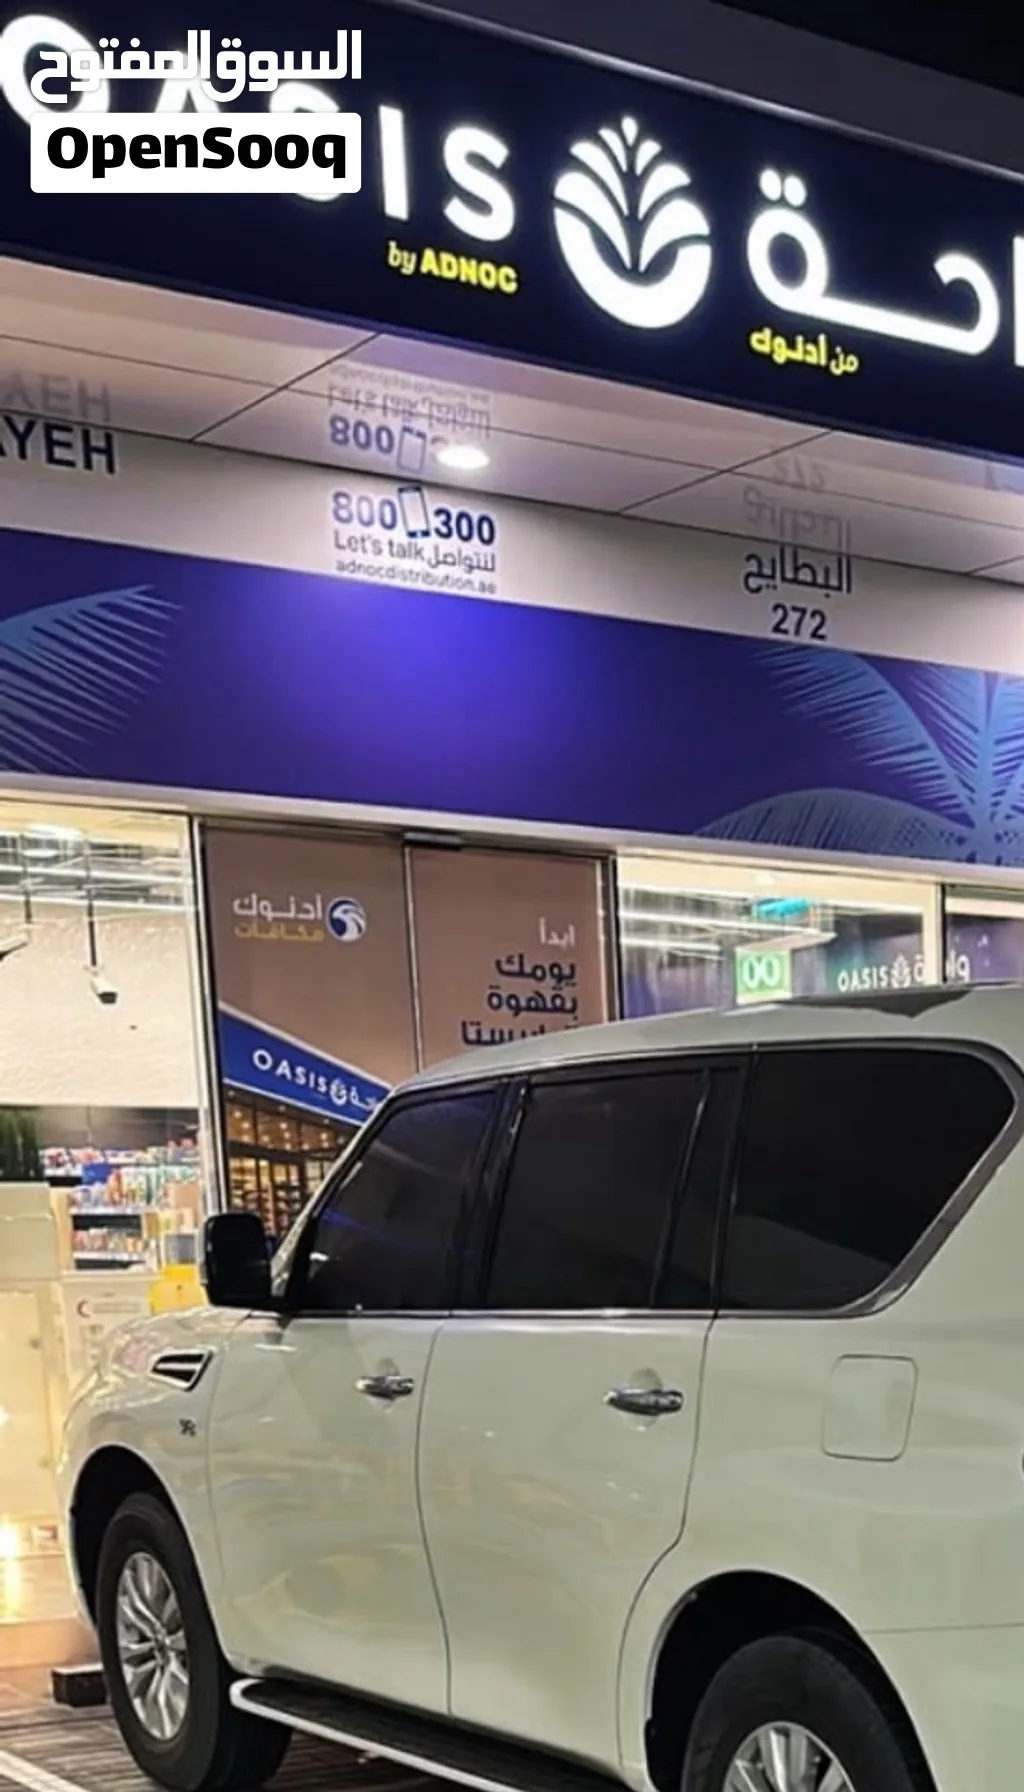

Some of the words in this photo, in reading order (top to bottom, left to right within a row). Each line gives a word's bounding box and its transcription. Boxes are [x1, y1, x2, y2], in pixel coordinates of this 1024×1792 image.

[388, 240, 417, 275] by
[420, 247, 518, 294] ADNOC
[829, 345, 859, 375] من
[0, 414, 116, 475] YEH
[332, 491, 398, 530] 800
[433, 507, 496, 546] 300
[334, 530, 383, 556] Let's
[388, 540, 425, 563] talk
[335, 558, 497, 595] adnocdistribution.ae
[770, 603, 828, 641] 272
[494, 953, 577, 987] يومك
[836, 963, 888, 992] OASIS
[487, 983, 579, 1021] بقهوة
[252, 1049, 328, 1094] OASIS
